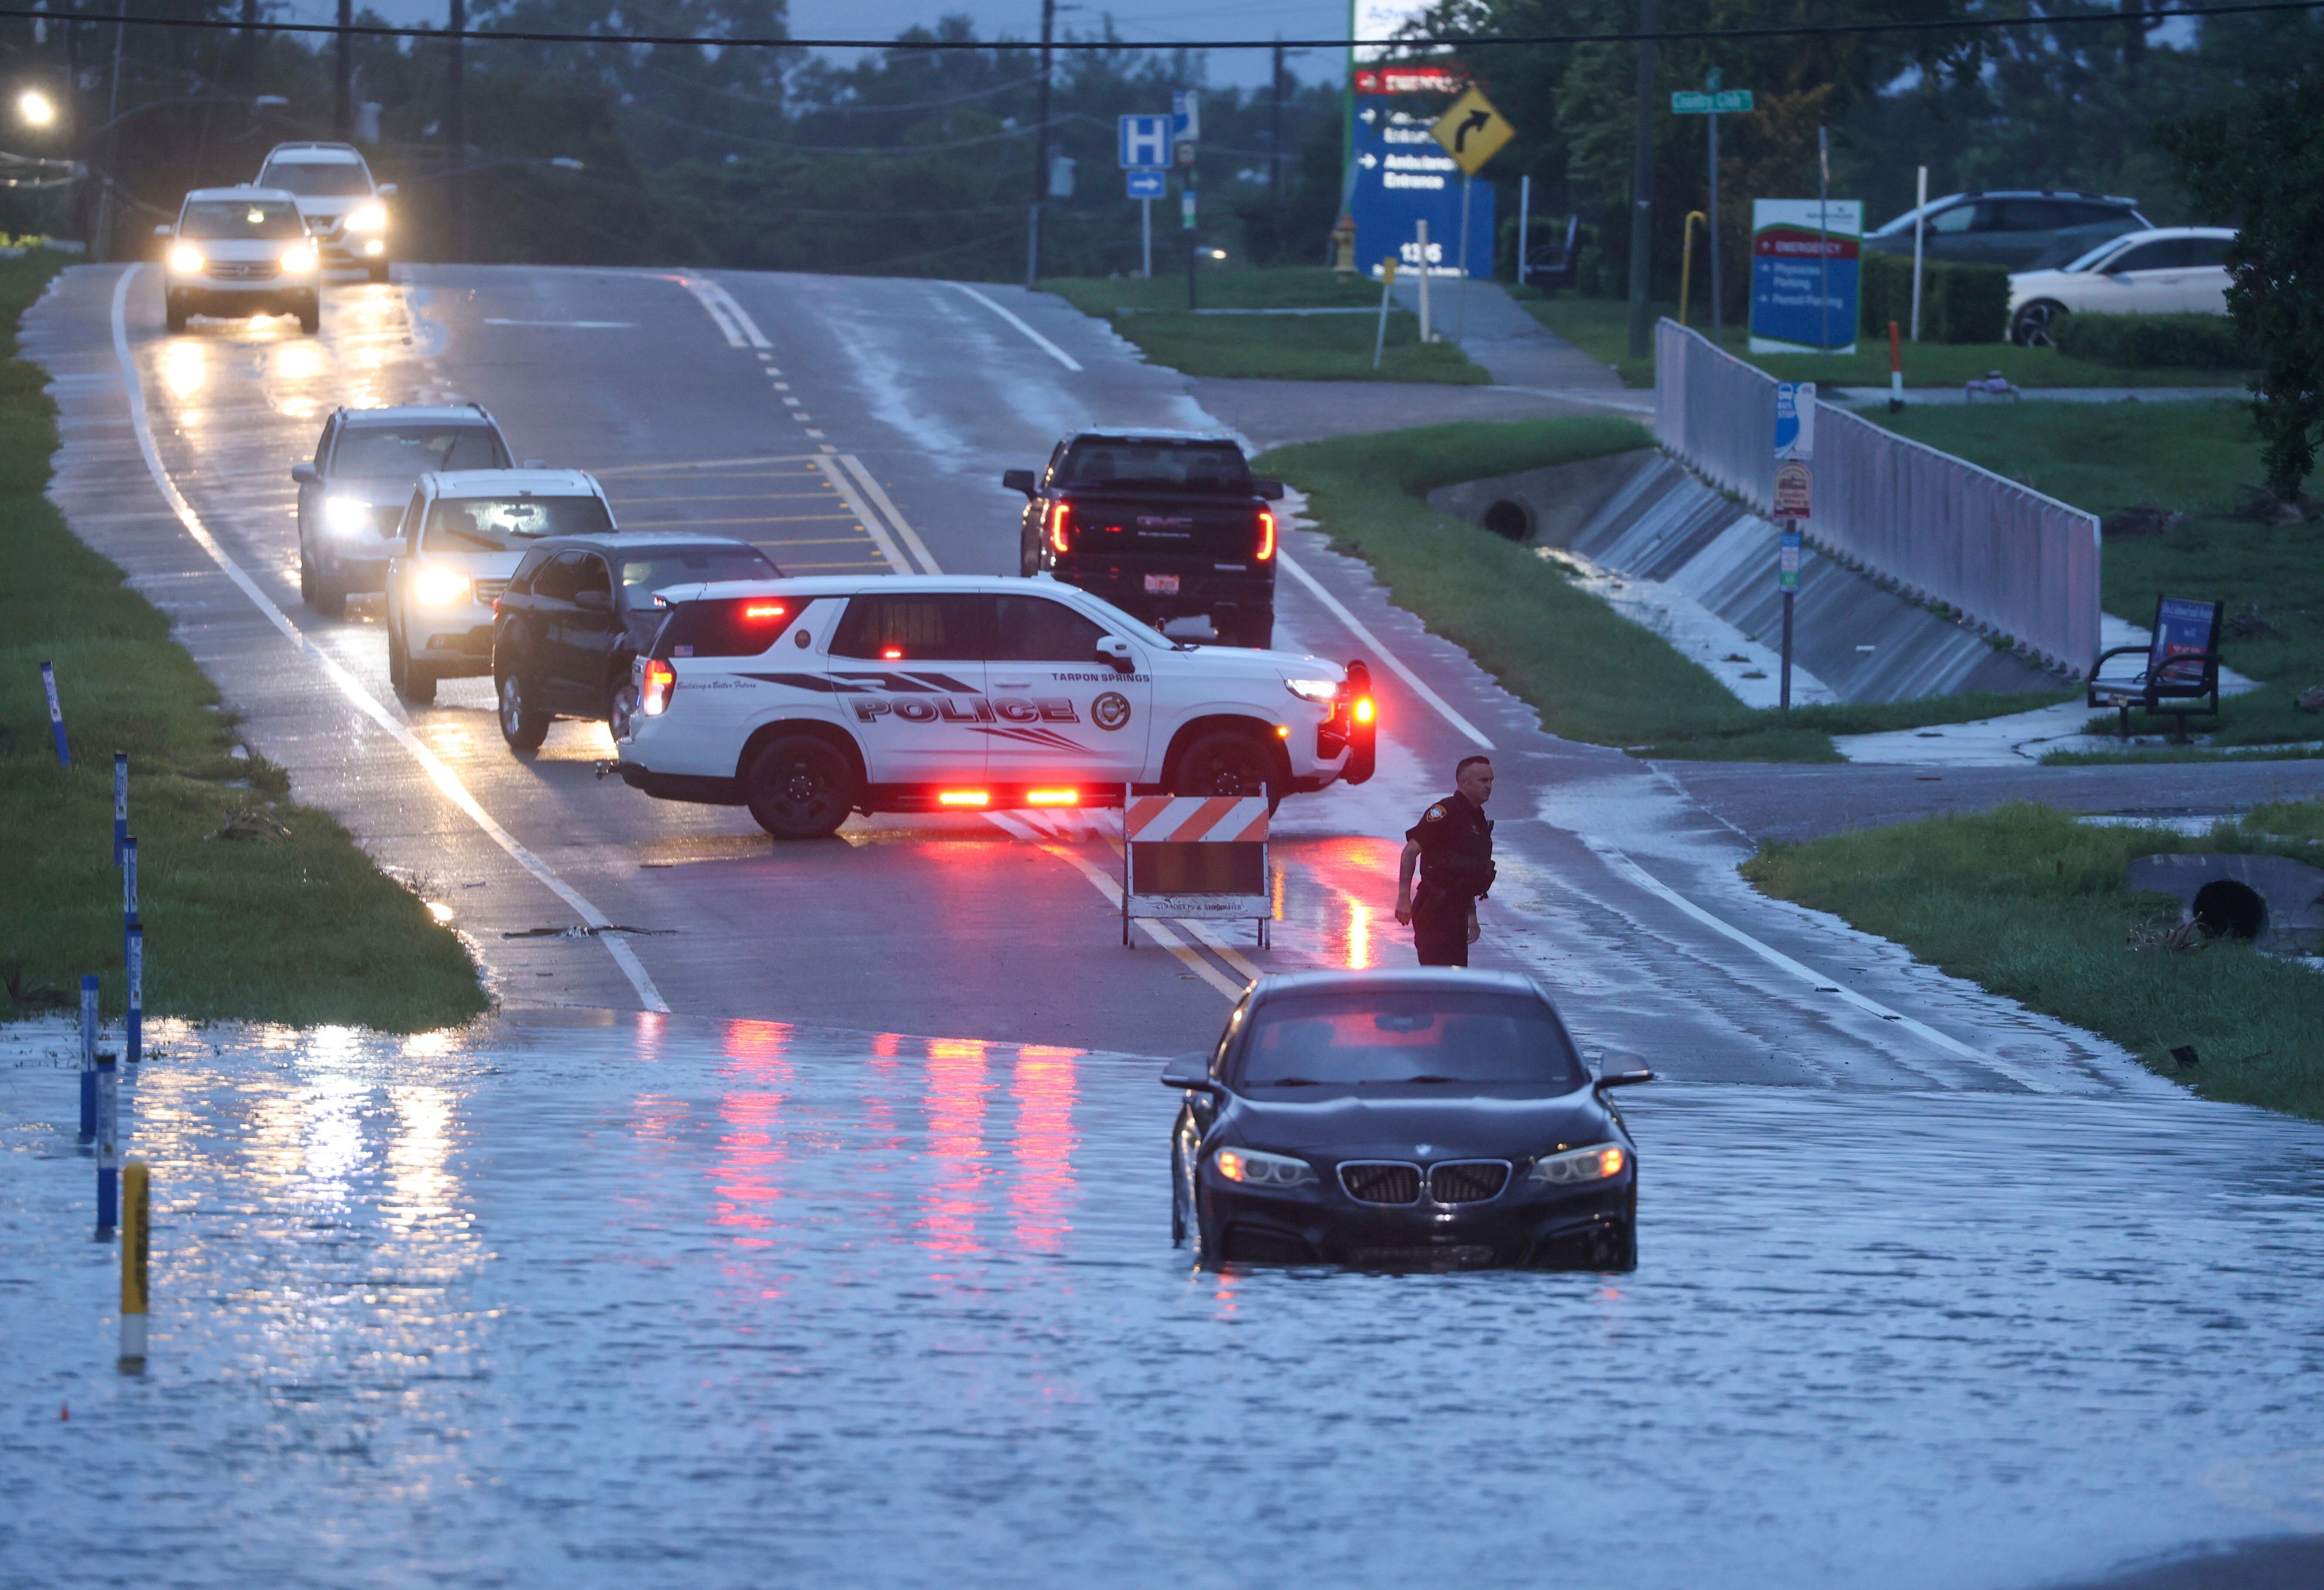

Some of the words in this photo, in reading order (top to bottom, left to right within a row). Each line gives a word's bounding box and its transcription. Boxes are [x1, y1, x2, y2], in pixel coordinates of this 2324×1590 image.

[1127, 119, 1164, 164] H
[677, 681, 706, 690] Building
[713, 680, 732, 689] Better
[734, 680, 756, 689] Future
[1052, 673, 1098, 681] TARPON
[1101, 674, 1150, 683] SPRINGS
[848, 696, 1081, 724] POLICE
